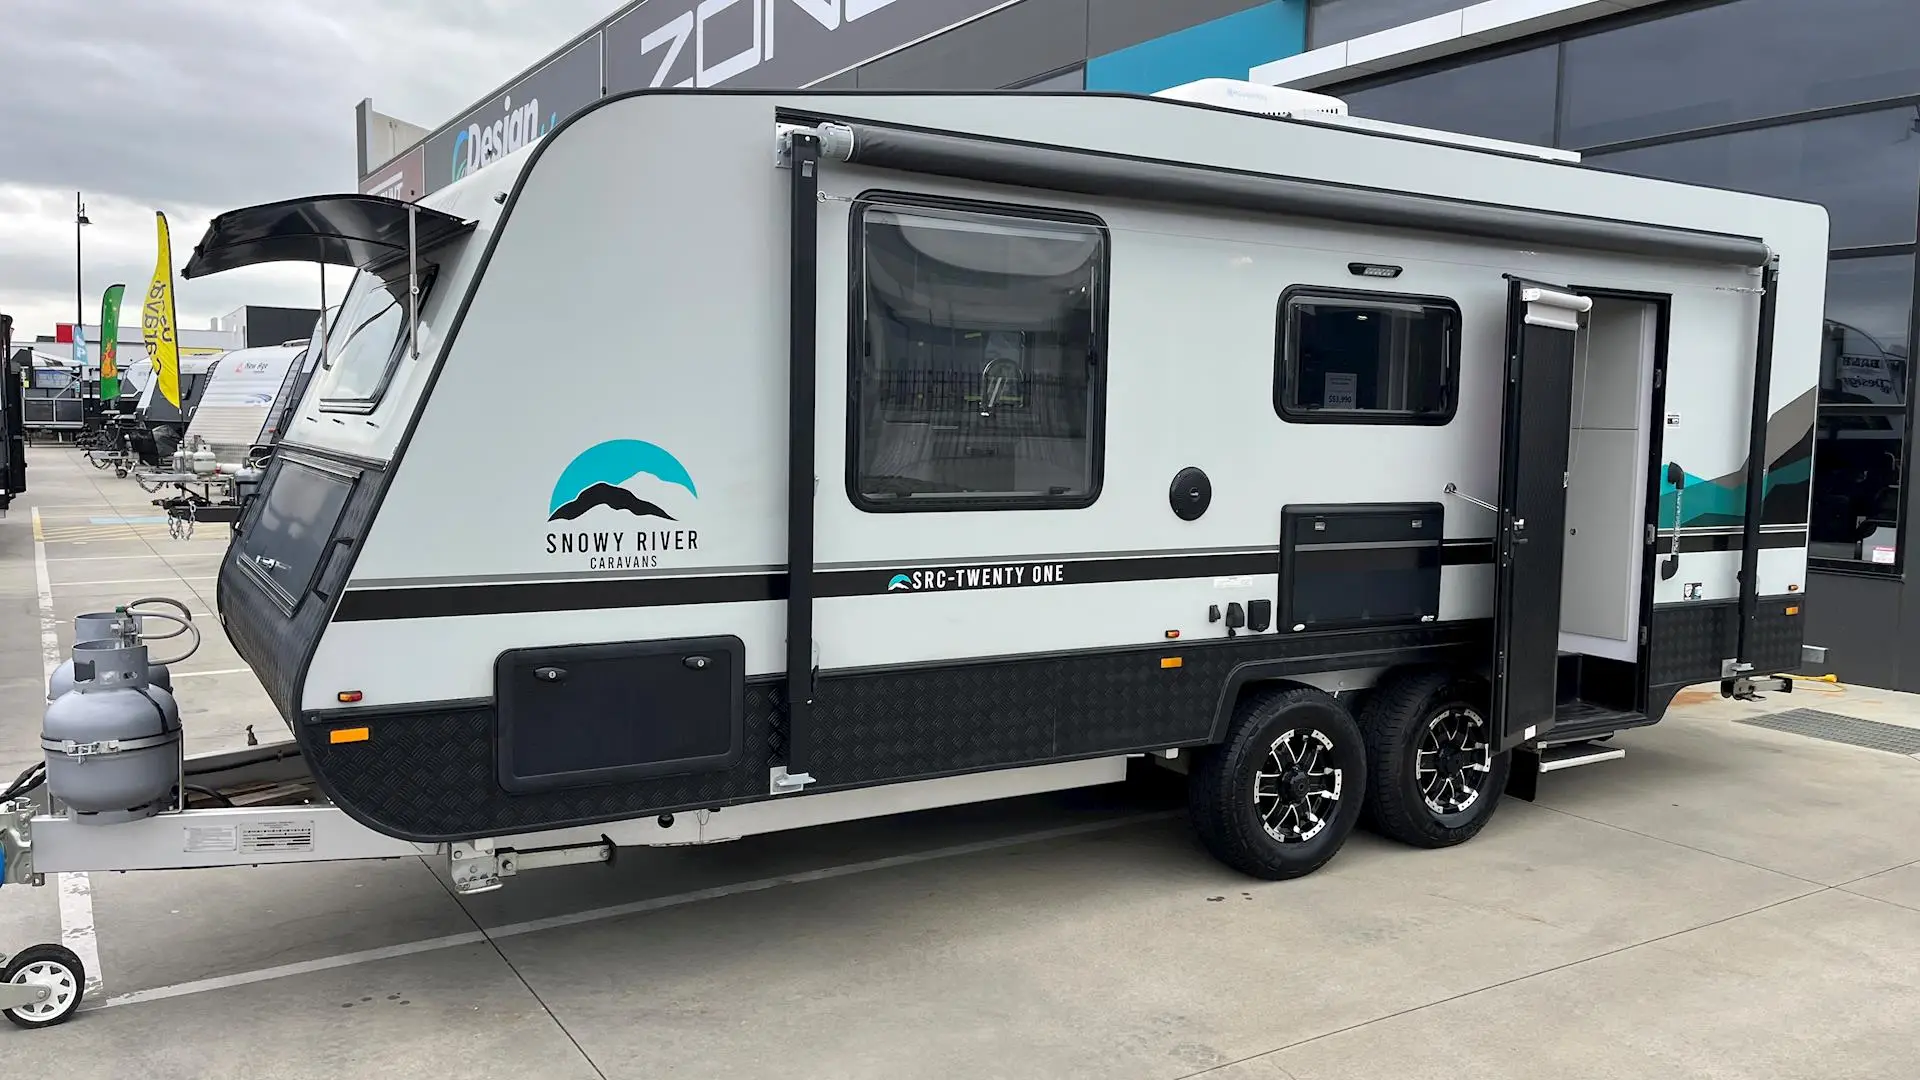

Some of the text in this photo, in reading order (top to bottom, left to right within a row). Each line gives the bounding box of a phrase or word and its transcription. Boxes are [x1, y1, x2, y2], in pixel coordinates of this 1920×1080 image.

[546, 530, 698, 554] SNOWY RIVER
[590, 555, 657, 569] CARAVANS
[912, 564, 1064, 590] SRC-TWENTY ONE
